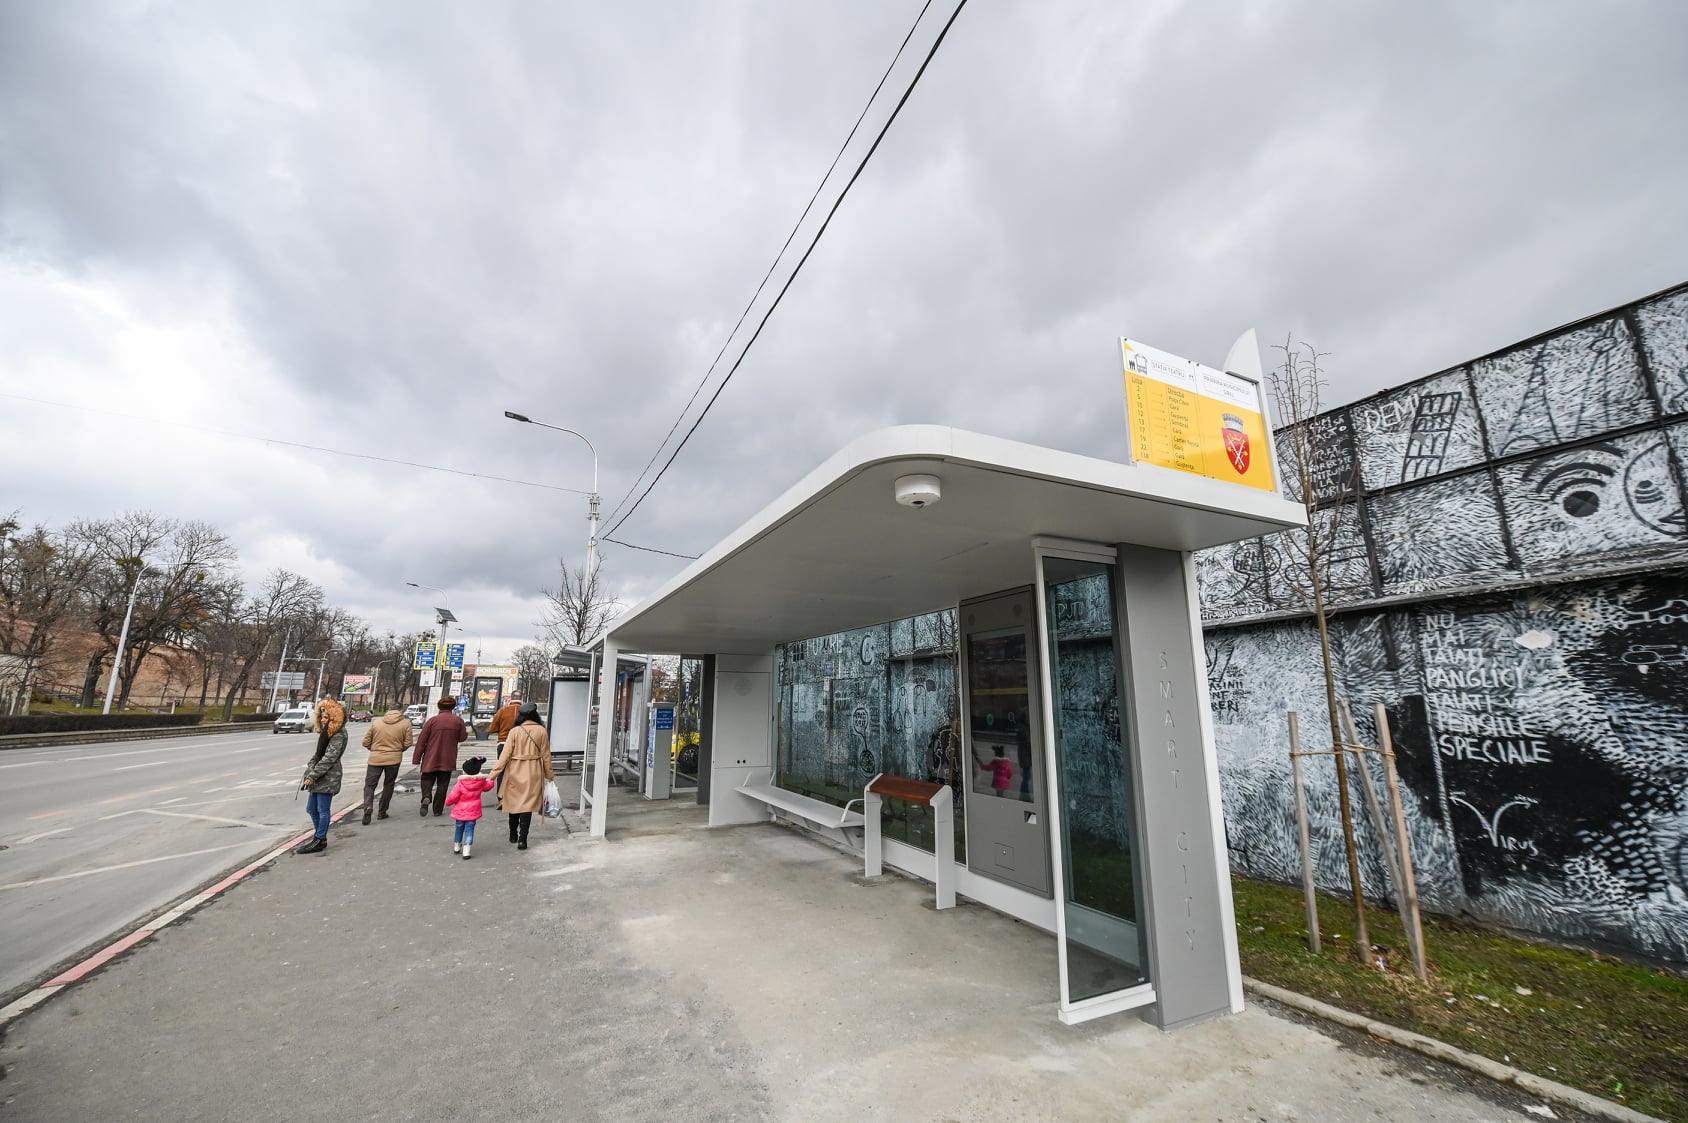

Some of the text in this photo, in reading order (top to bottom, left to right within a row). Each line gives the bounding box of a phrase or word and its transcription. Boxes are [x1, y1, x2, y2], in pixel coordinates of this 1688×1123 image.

[1426, 612, 1455, 632] NU
[1422, 629, 1466, 649] MAI
[1425, 666, 1524, 690] PANGLICI
[1438, 733, 1553, 766] SPECIALE
[1159, 651, 1196, 951] SMART CITY
